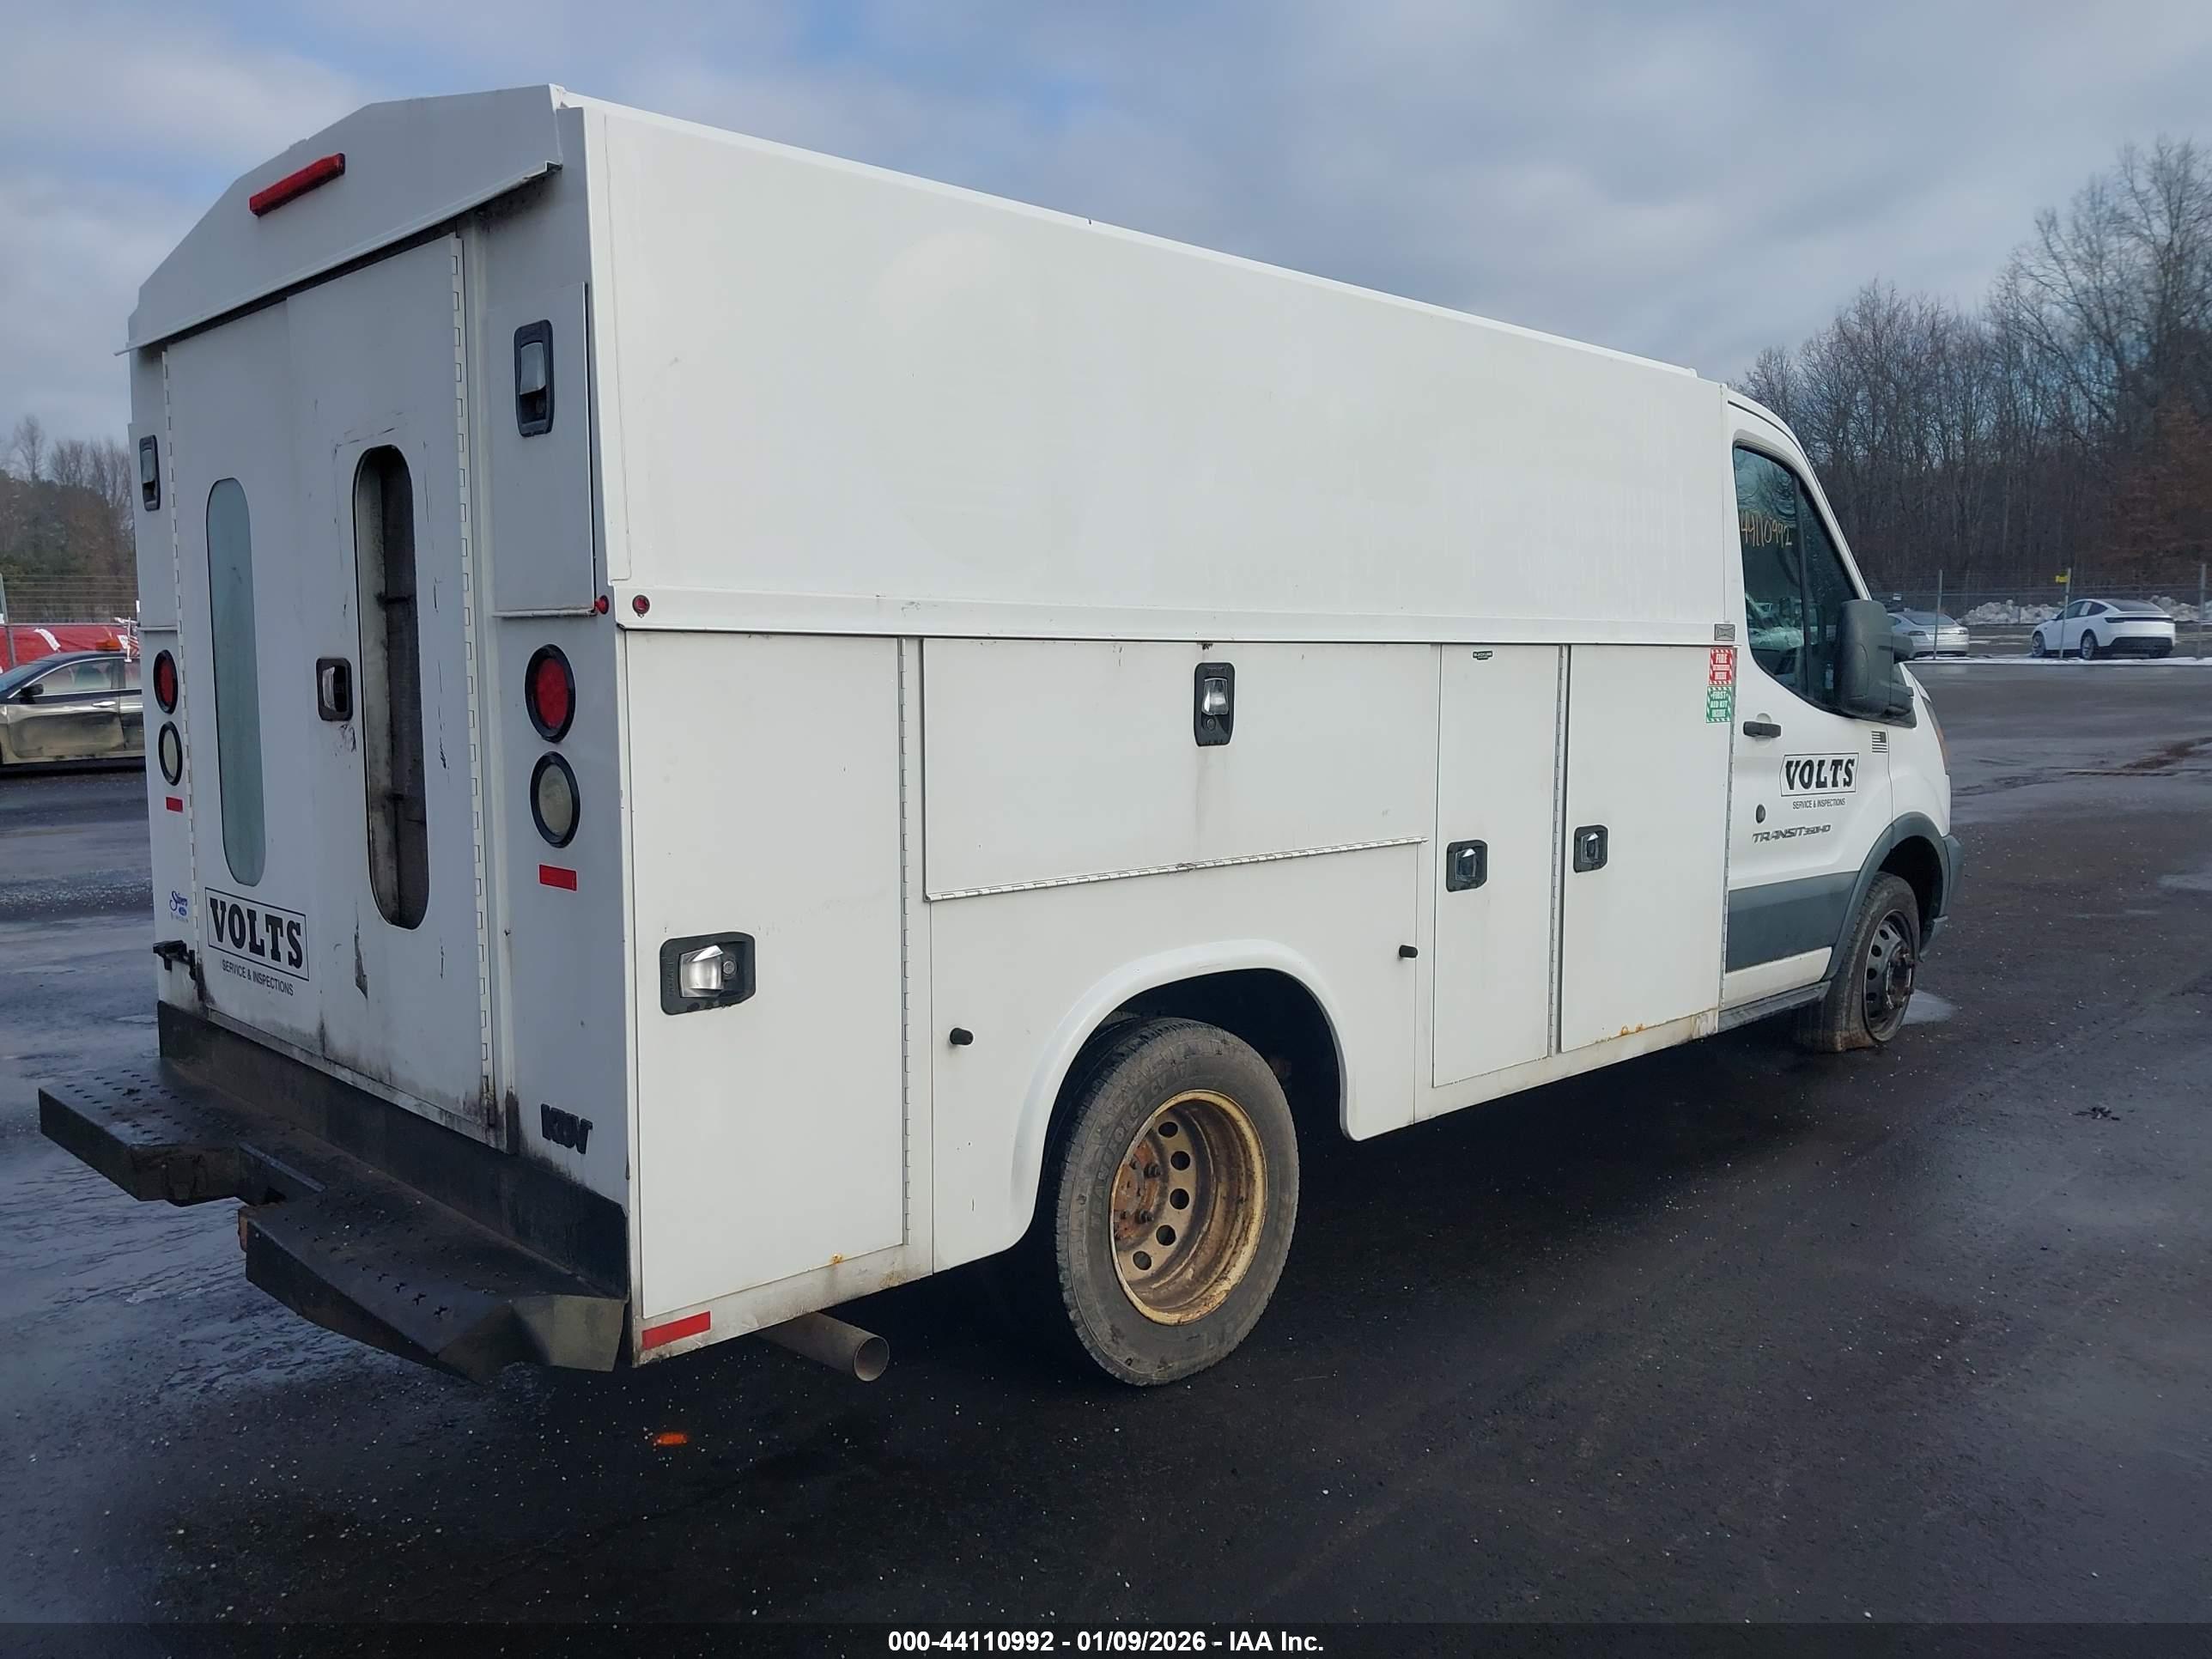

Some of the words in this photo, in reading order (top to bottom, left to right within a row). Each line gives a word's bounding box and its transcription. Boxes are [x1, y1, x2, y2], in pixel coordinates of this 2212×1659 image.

[1784, 757, 1856, 791] VOLTS
[1792, 799, 1813, 810] SERVICE
[1817, 798, 1845, 808] INSPECTIONS
[210, 897, 303, 969] VOLTS
[222, 958, 246, 979] SERVICE
[247, 969, 252, 981] &
[252, 970, 294, 996] INSPECTIONS
